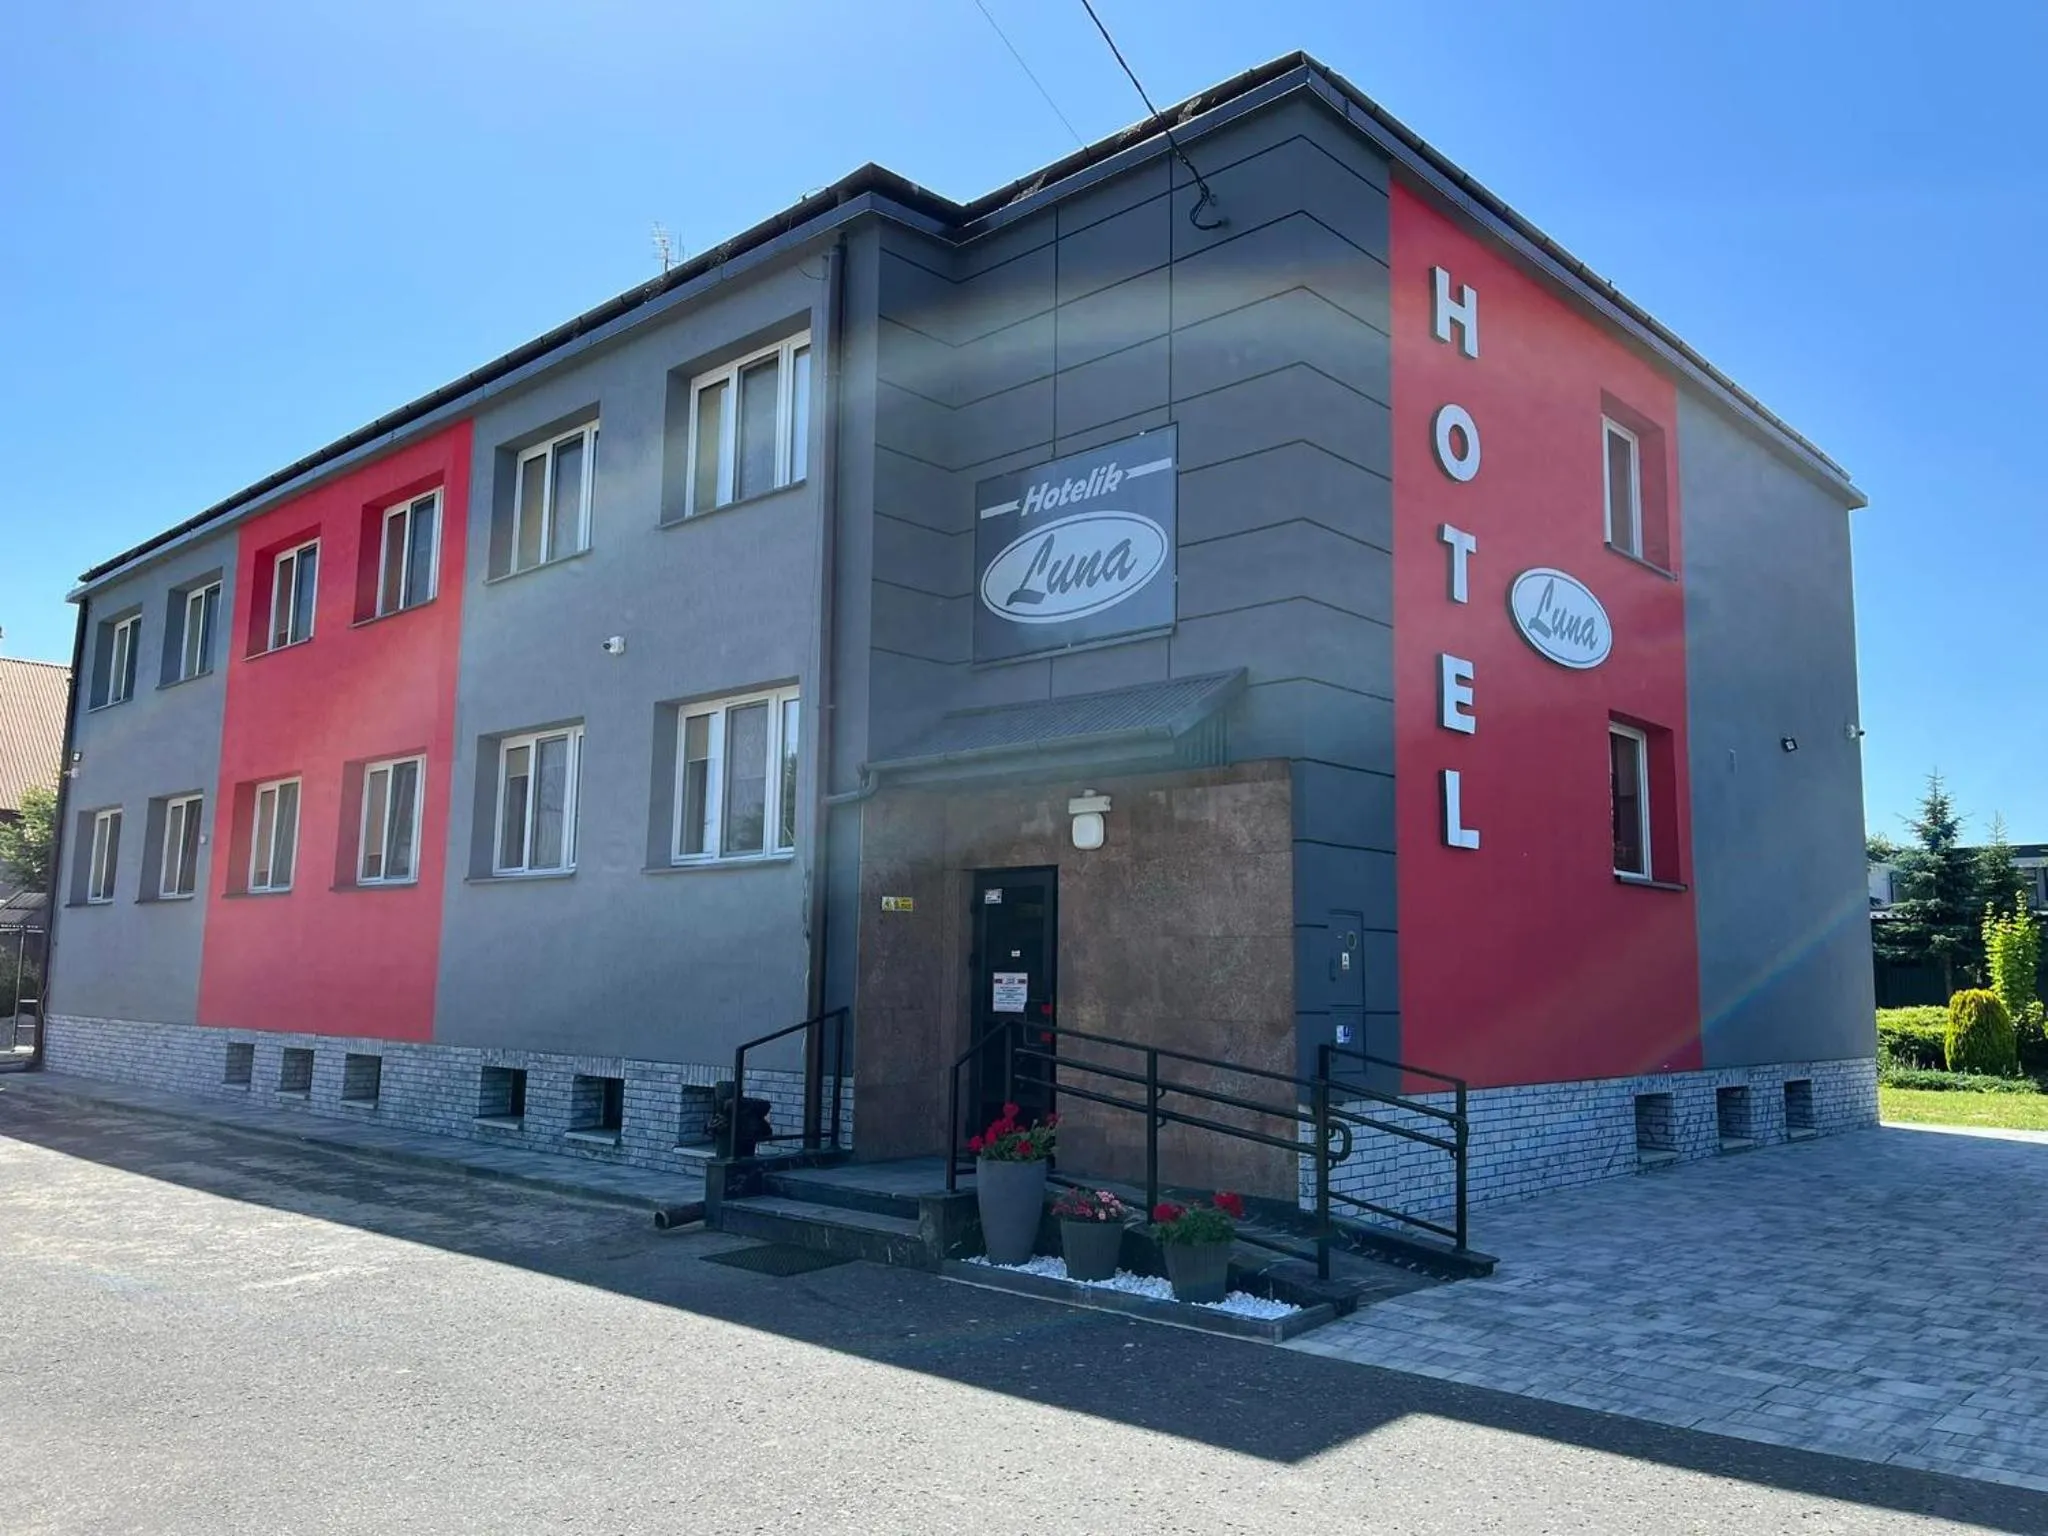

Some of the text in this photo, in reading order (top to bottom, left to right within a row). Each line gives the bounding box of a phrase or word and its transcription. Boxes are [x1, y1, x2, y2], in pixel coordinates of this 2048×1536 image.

[1020, 462, 1123, 516] Hotelik
[1006, 533, 1137, 606] Luna
[1431, 266, 1480, 849] HOTEL
[1528, 578, 1598, 650] Luna
